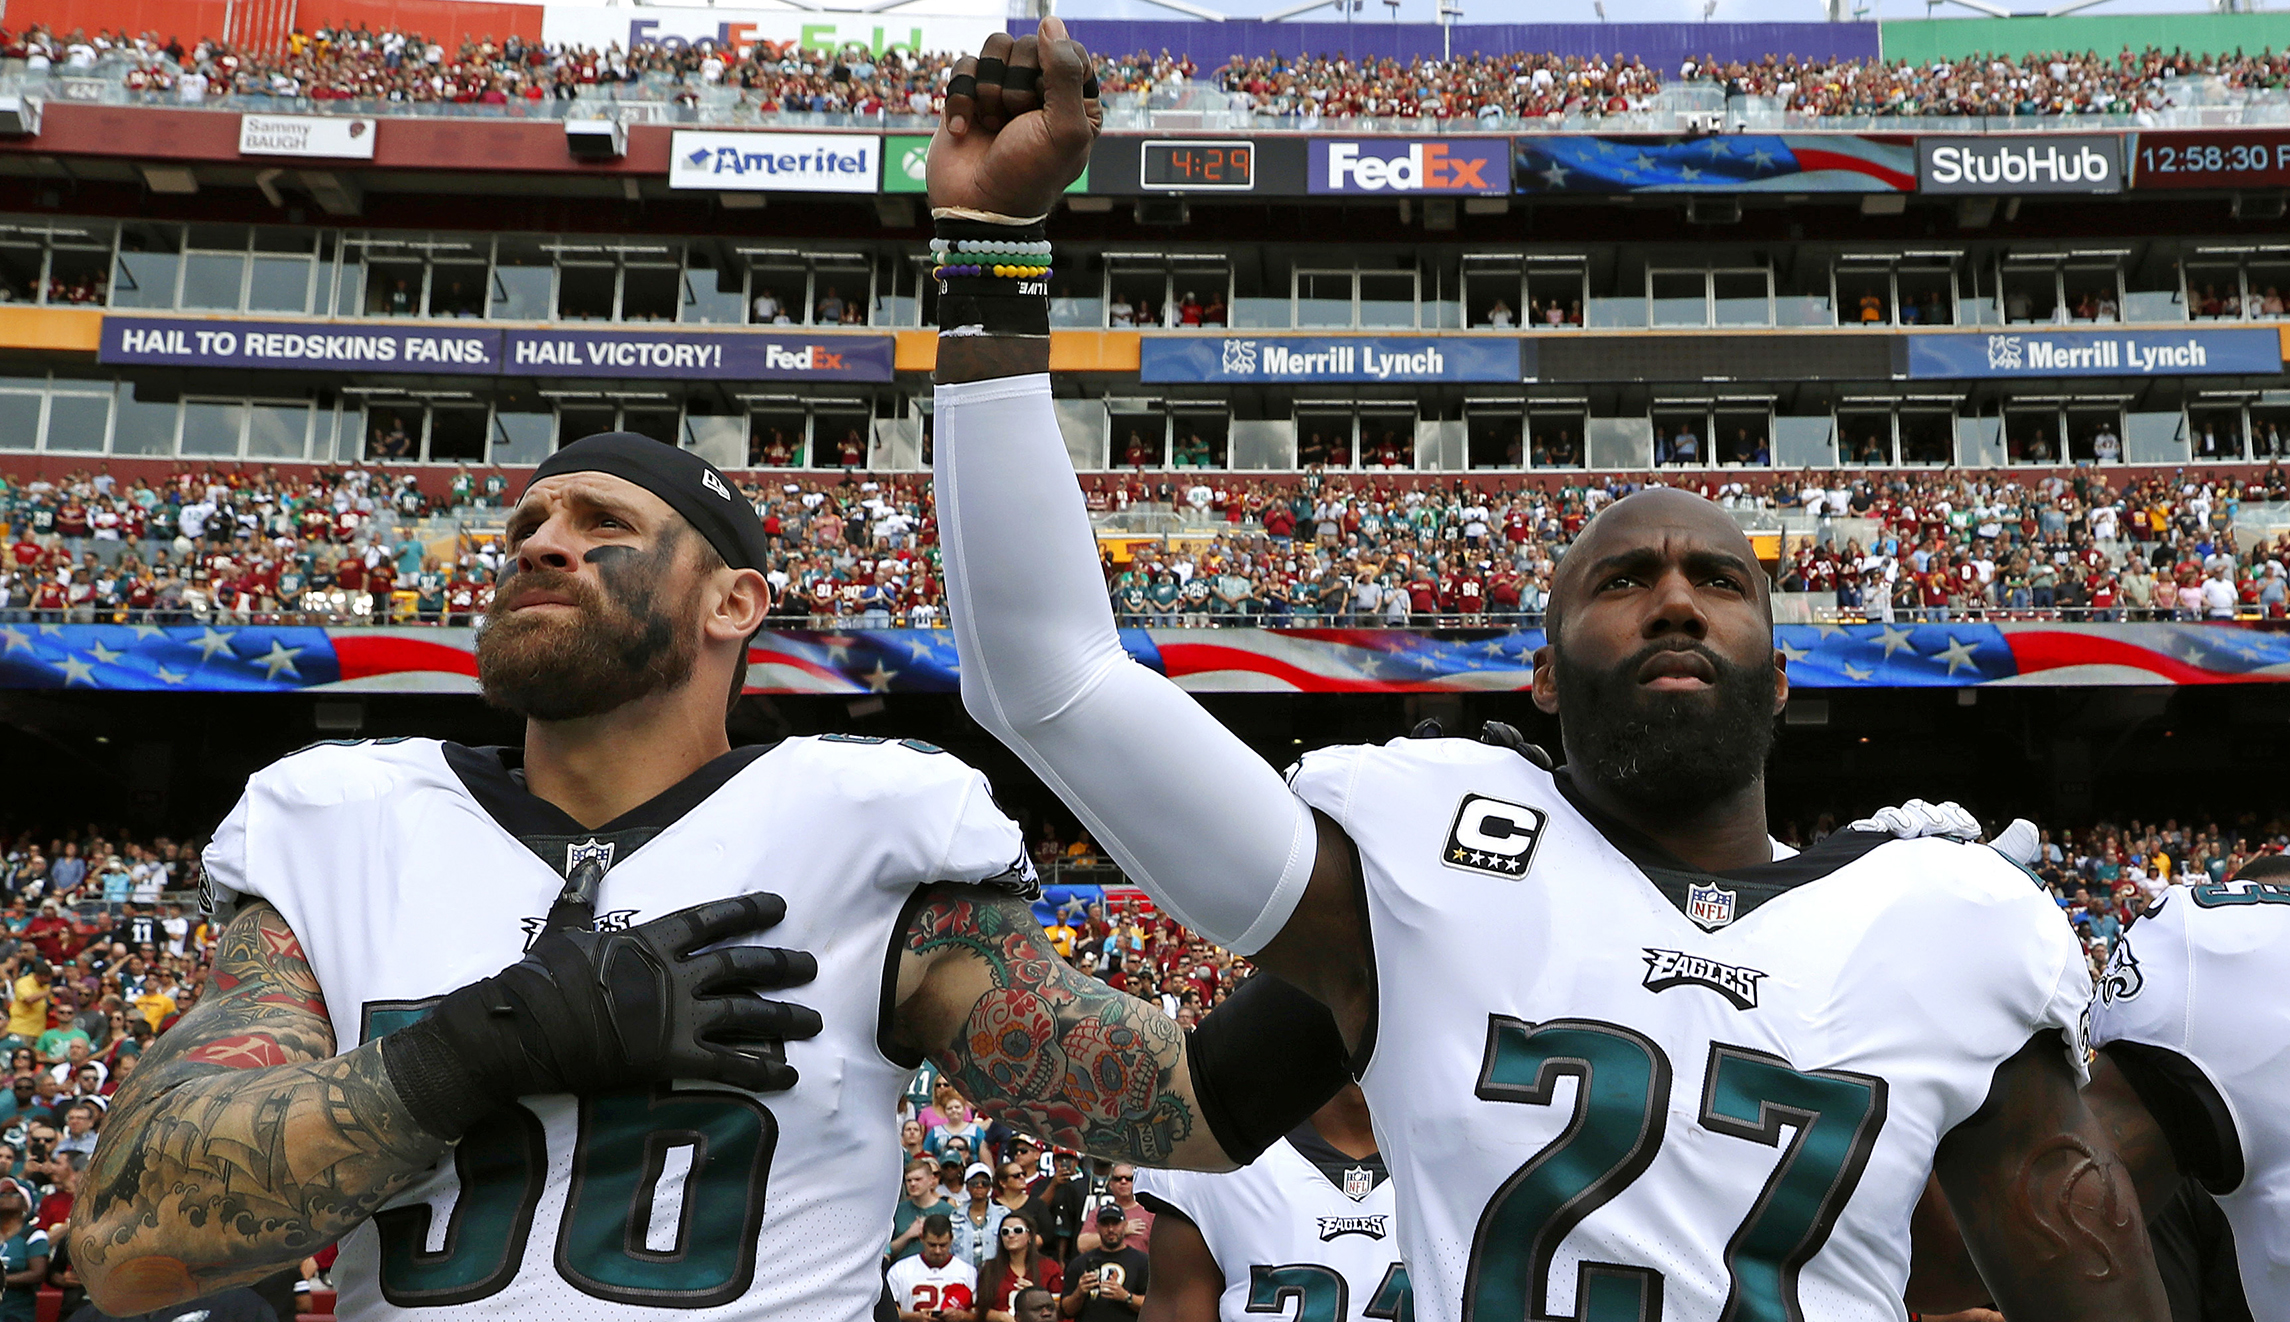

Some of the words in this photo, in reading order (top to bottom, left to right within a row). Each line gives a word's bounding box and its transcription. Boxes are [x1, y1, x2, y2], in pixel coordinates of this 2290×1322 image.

[248, 119, 310, 135] Sammy
[246, 134, 307, 150] BAUGH
[714, 147, 867, 175] Ameritel
[1172, 149, 1249, 181] 4:29
[1328, 143, 1489, 190] FedEx
[1931, 146, 2109, 184] StubHub
[2142, 144, 2269, 173] 12:58:30
[121, 328, 193, 355] HAIL
[196, 330, 237, 357] TO
[244, 332, 398, 362] REDSKINS
[404, 336, 491, 364] FANS.
[515, 340, 583, 366] HAIL
[586, 341, 723, 368] VICTORY!
[764, 344, 845, 370] FedEx
[2027, 339, 2120, 369] Merrill
[2126, 339, 2208, 372] Lynch
[1262, 346, 1355, 374] Merrill
[1362, 346, 1445, 379] Lynch
[1455, 798, 1539, 857] C
[1694, 901, 1727, 921] NFL
[131, 924, 153, 944] 11
[1642, 947, 1769, 1011] EAGLES
[1461, 1012, 1890, 1322] 27
[1350, 1181, 1368, 1194] NFL
[1316, 1215, 1390, 1242] EAGLES
